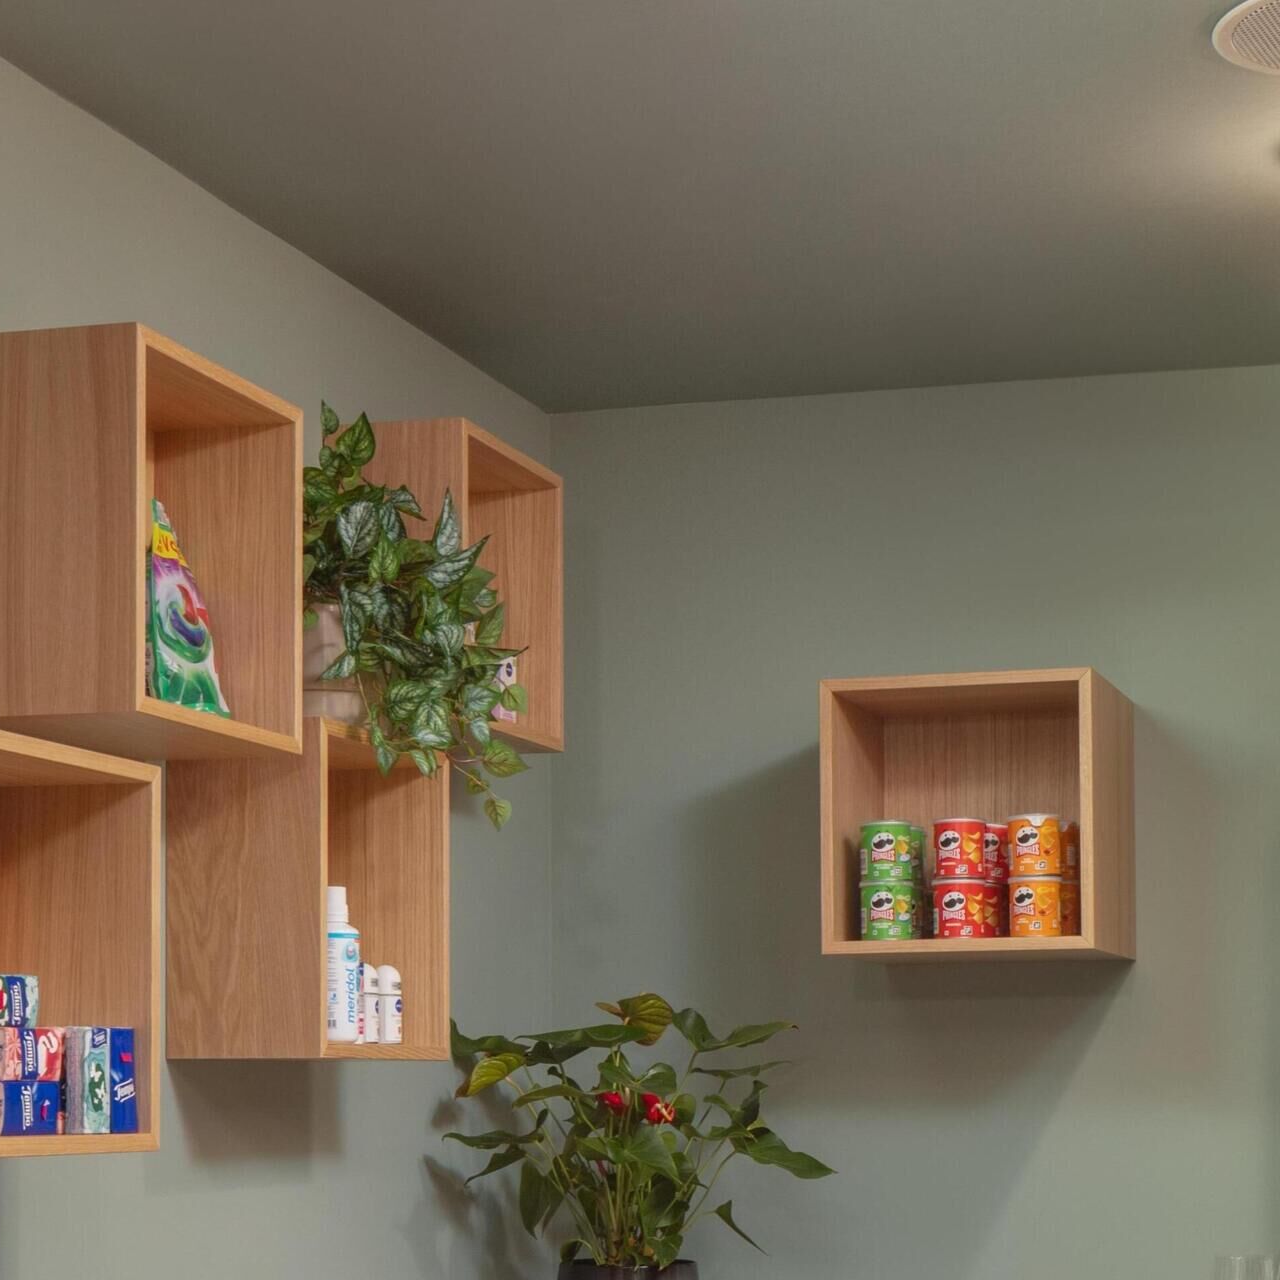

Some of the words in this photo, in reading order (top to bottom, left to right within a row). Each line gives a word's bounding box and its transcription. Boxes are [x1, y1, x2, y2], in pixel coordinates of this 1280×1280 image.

[345, 968, 355, 1024] meridol
[23, 1031, 34, 1073] Tempo
[22, 1085, 31, 1128] Tempo
